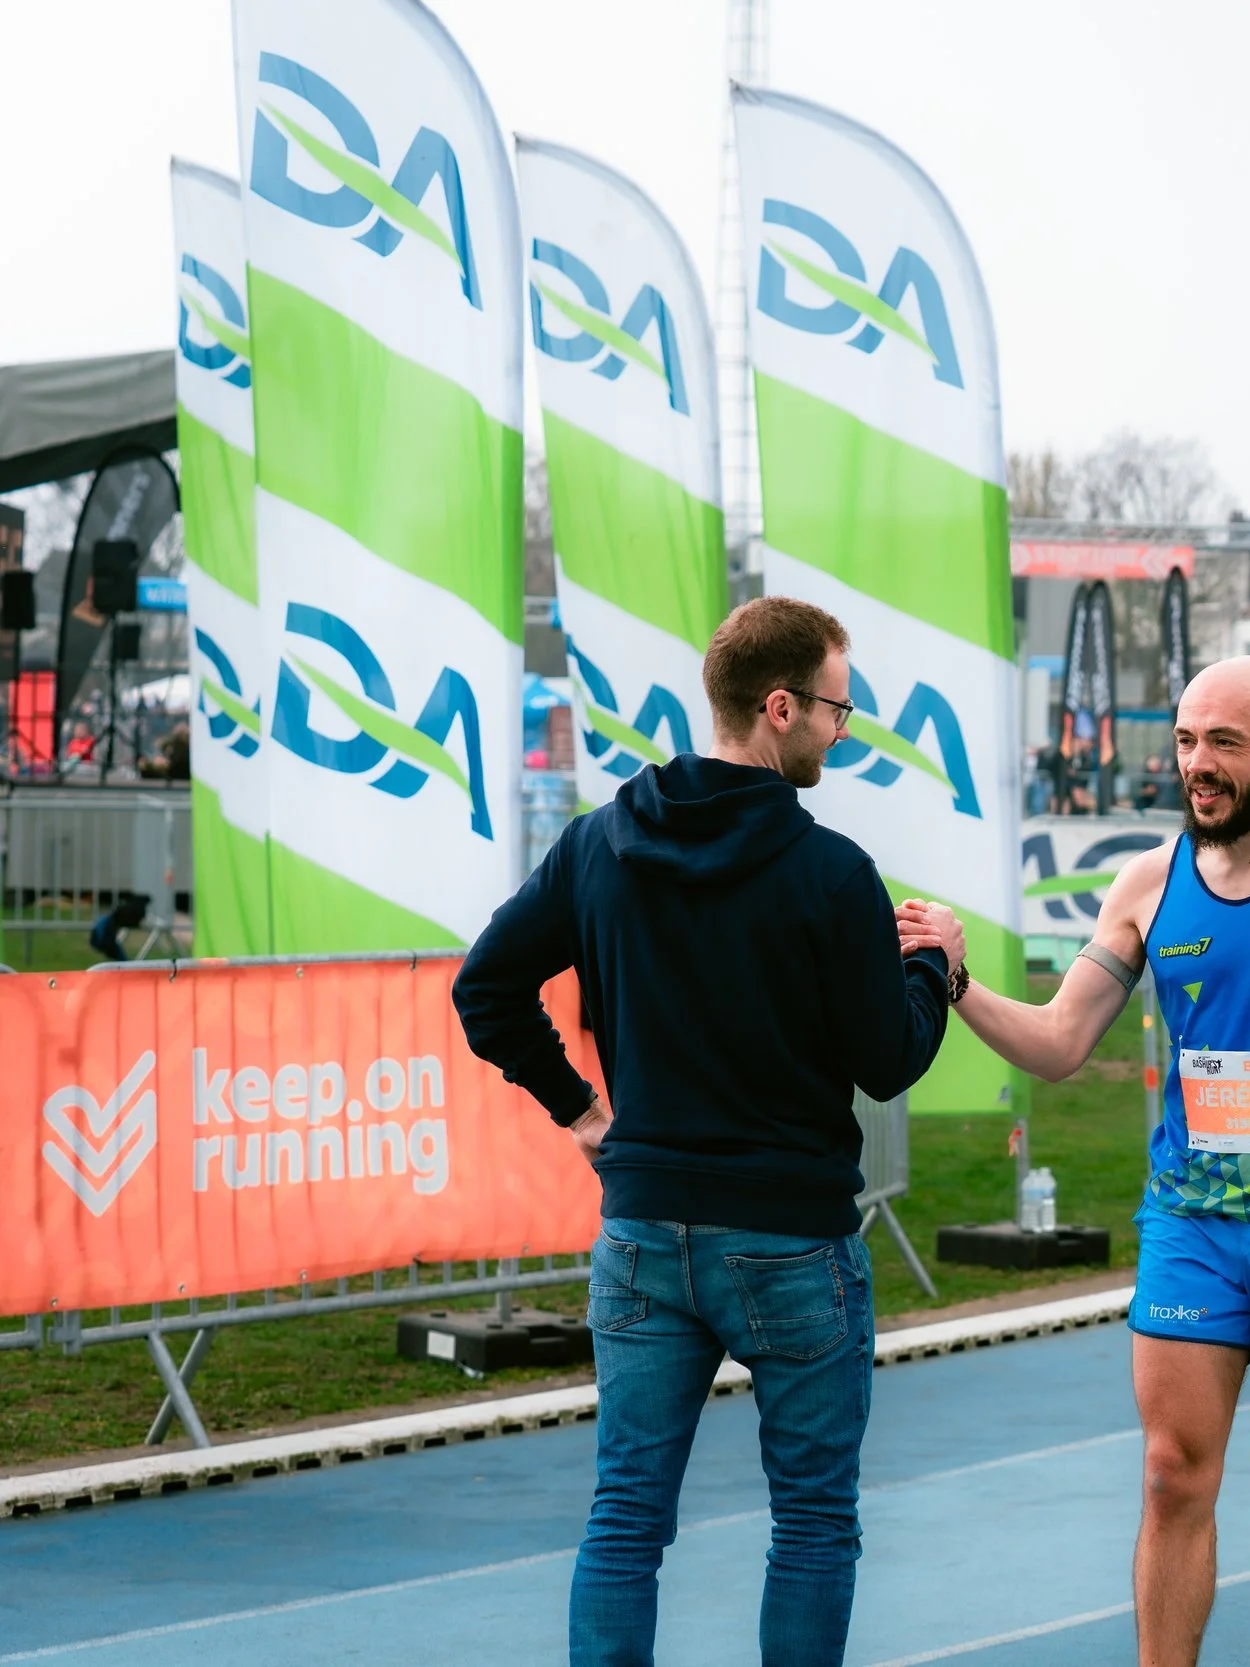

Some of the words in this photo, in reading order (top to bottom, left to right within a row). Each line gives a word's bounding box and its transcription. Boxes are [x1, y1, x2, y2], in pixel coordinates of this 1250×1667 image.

[250, 50, 484, 312] DA
[178, 251, 252, 390] D
[530, 237, 691, 417] DA
[756, 197, 965, 391] DA
[270, 600, 494, 841] DA
[1158, 937, 1212, 958] training7
[192, 1101, 450, 1195] running
[1149, 1302, 1200, 1322] trakks
